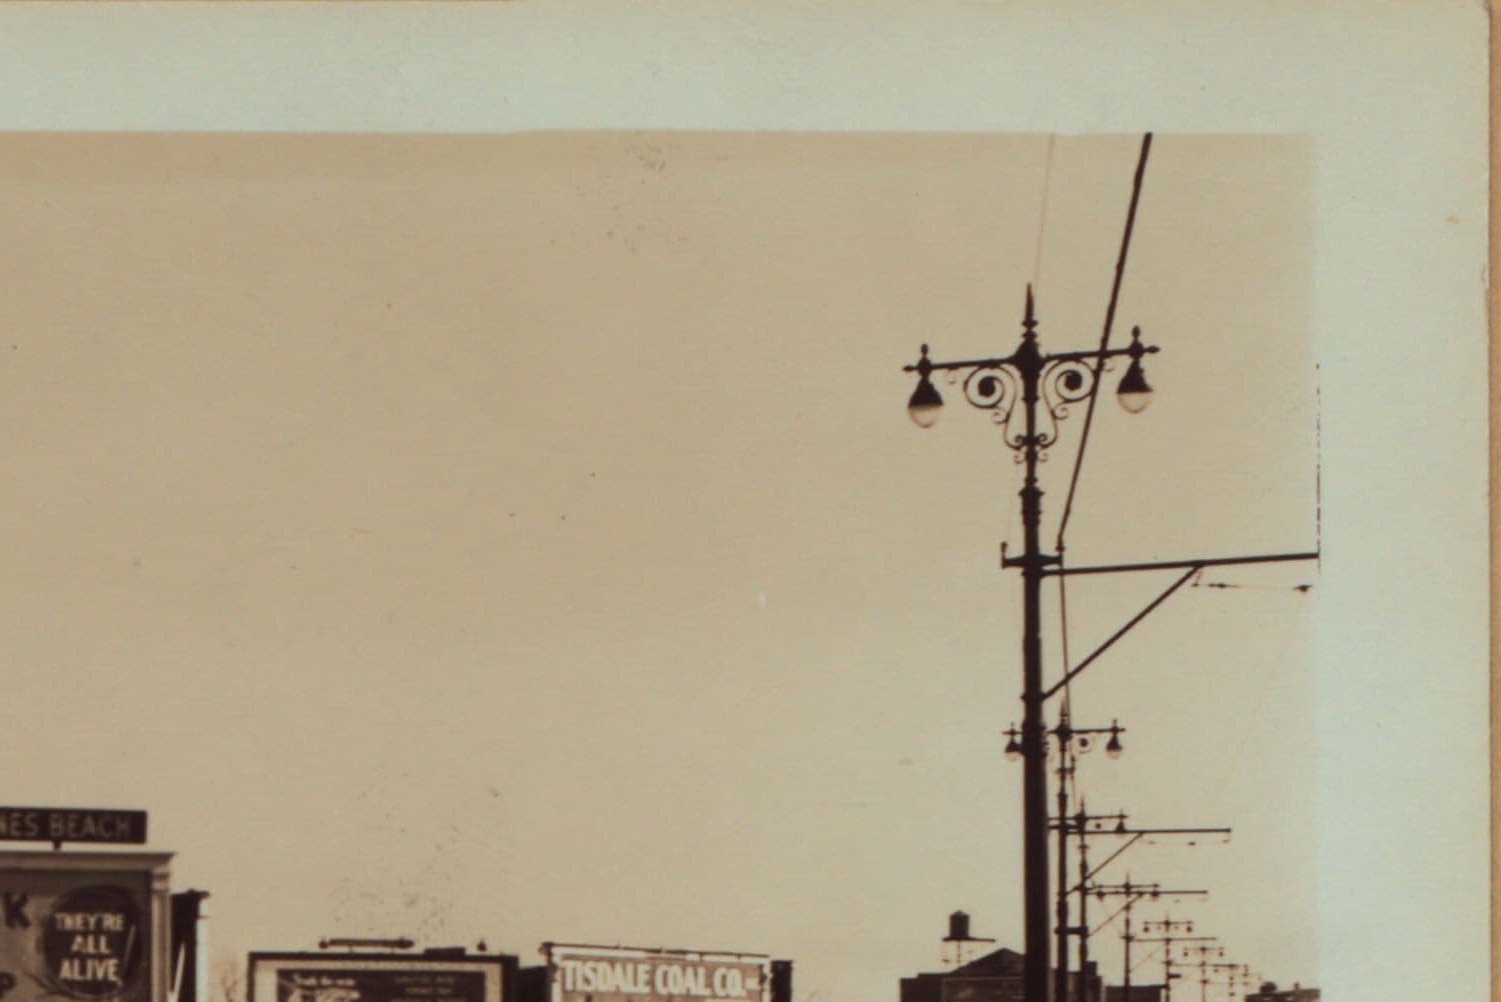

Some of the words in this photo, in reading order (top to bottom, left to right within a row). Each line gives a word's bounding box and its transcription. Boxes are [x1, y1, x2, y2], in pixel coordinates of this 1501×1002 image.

[50, 813, 131, 840] BEACH
[70, 934, 112, 954] ALL
[561, 960, 651, 994] TISDALE
[654, 964, 713, 996] COAL
